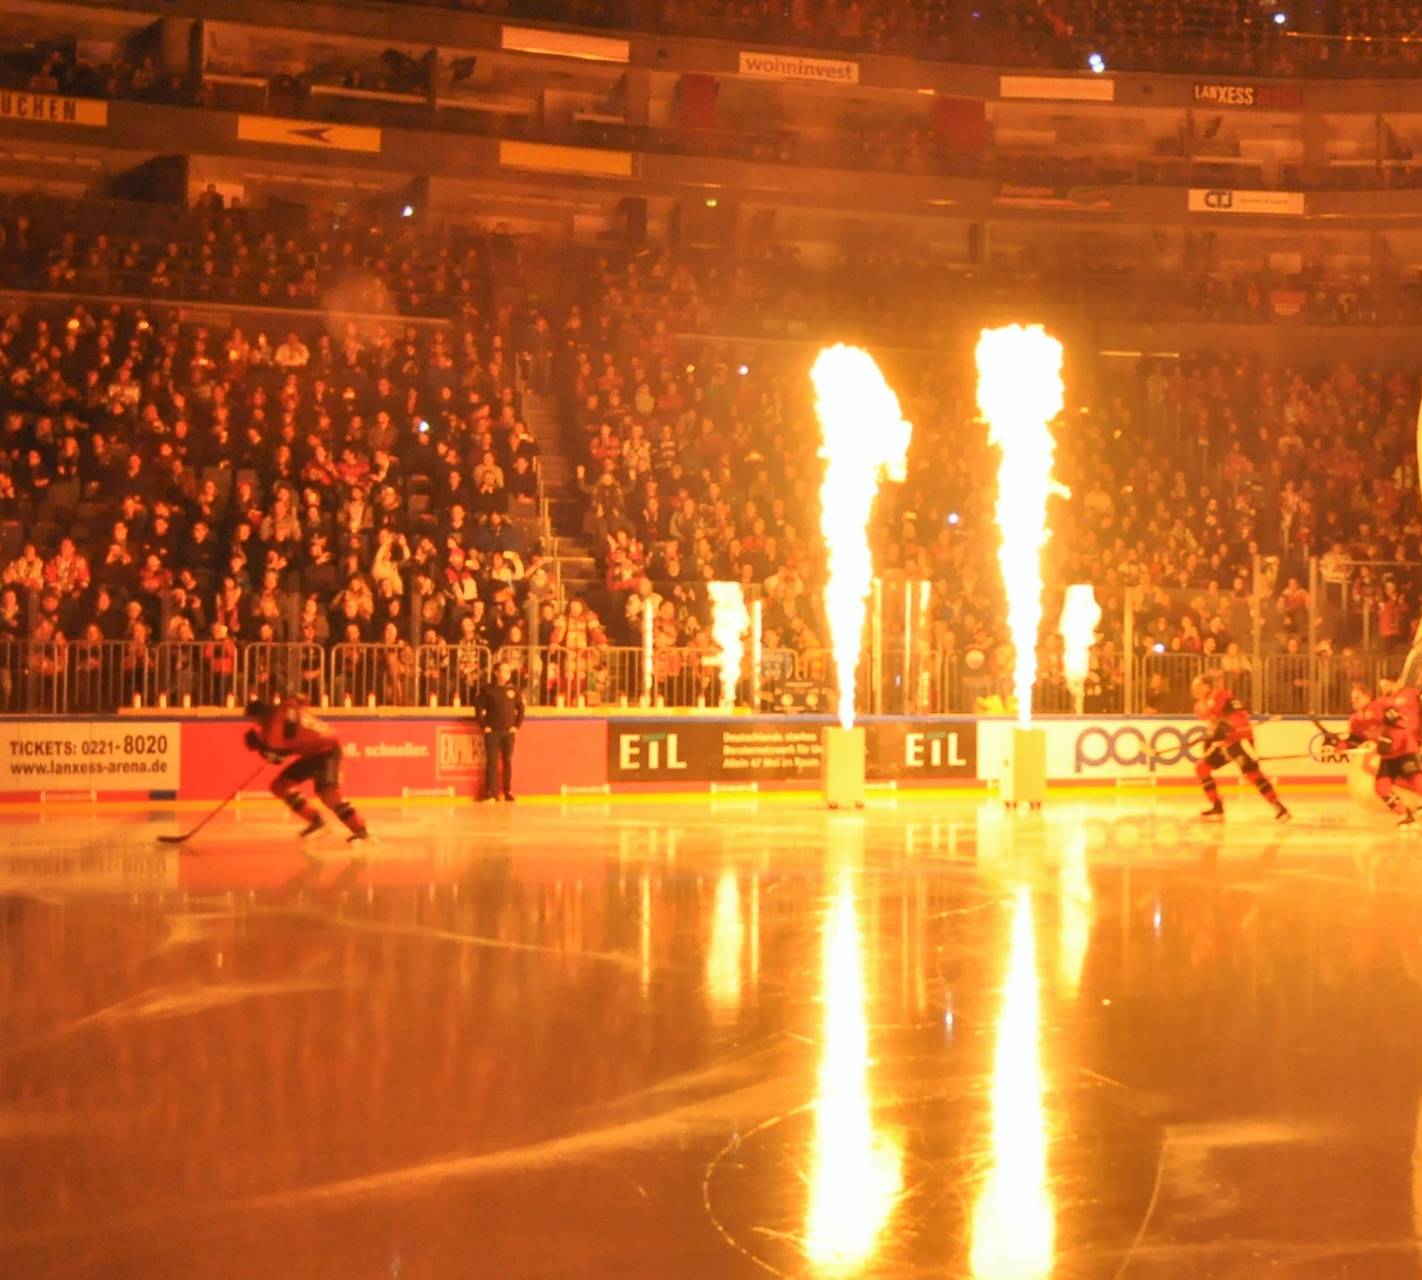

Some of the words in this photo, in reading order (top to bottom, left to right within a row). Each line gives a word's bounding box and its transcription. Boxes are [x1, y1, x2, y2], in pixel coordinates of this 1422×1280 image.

[746, 55, 853, 81] wohninvest
[1194, 84, 1254, 105] LANXESS
[1, 94, 76, 121] UCHEN
[9, 740, 77, 756] TICKETS:
[10, 760, 168, 775] www.lanxess-arena.de
